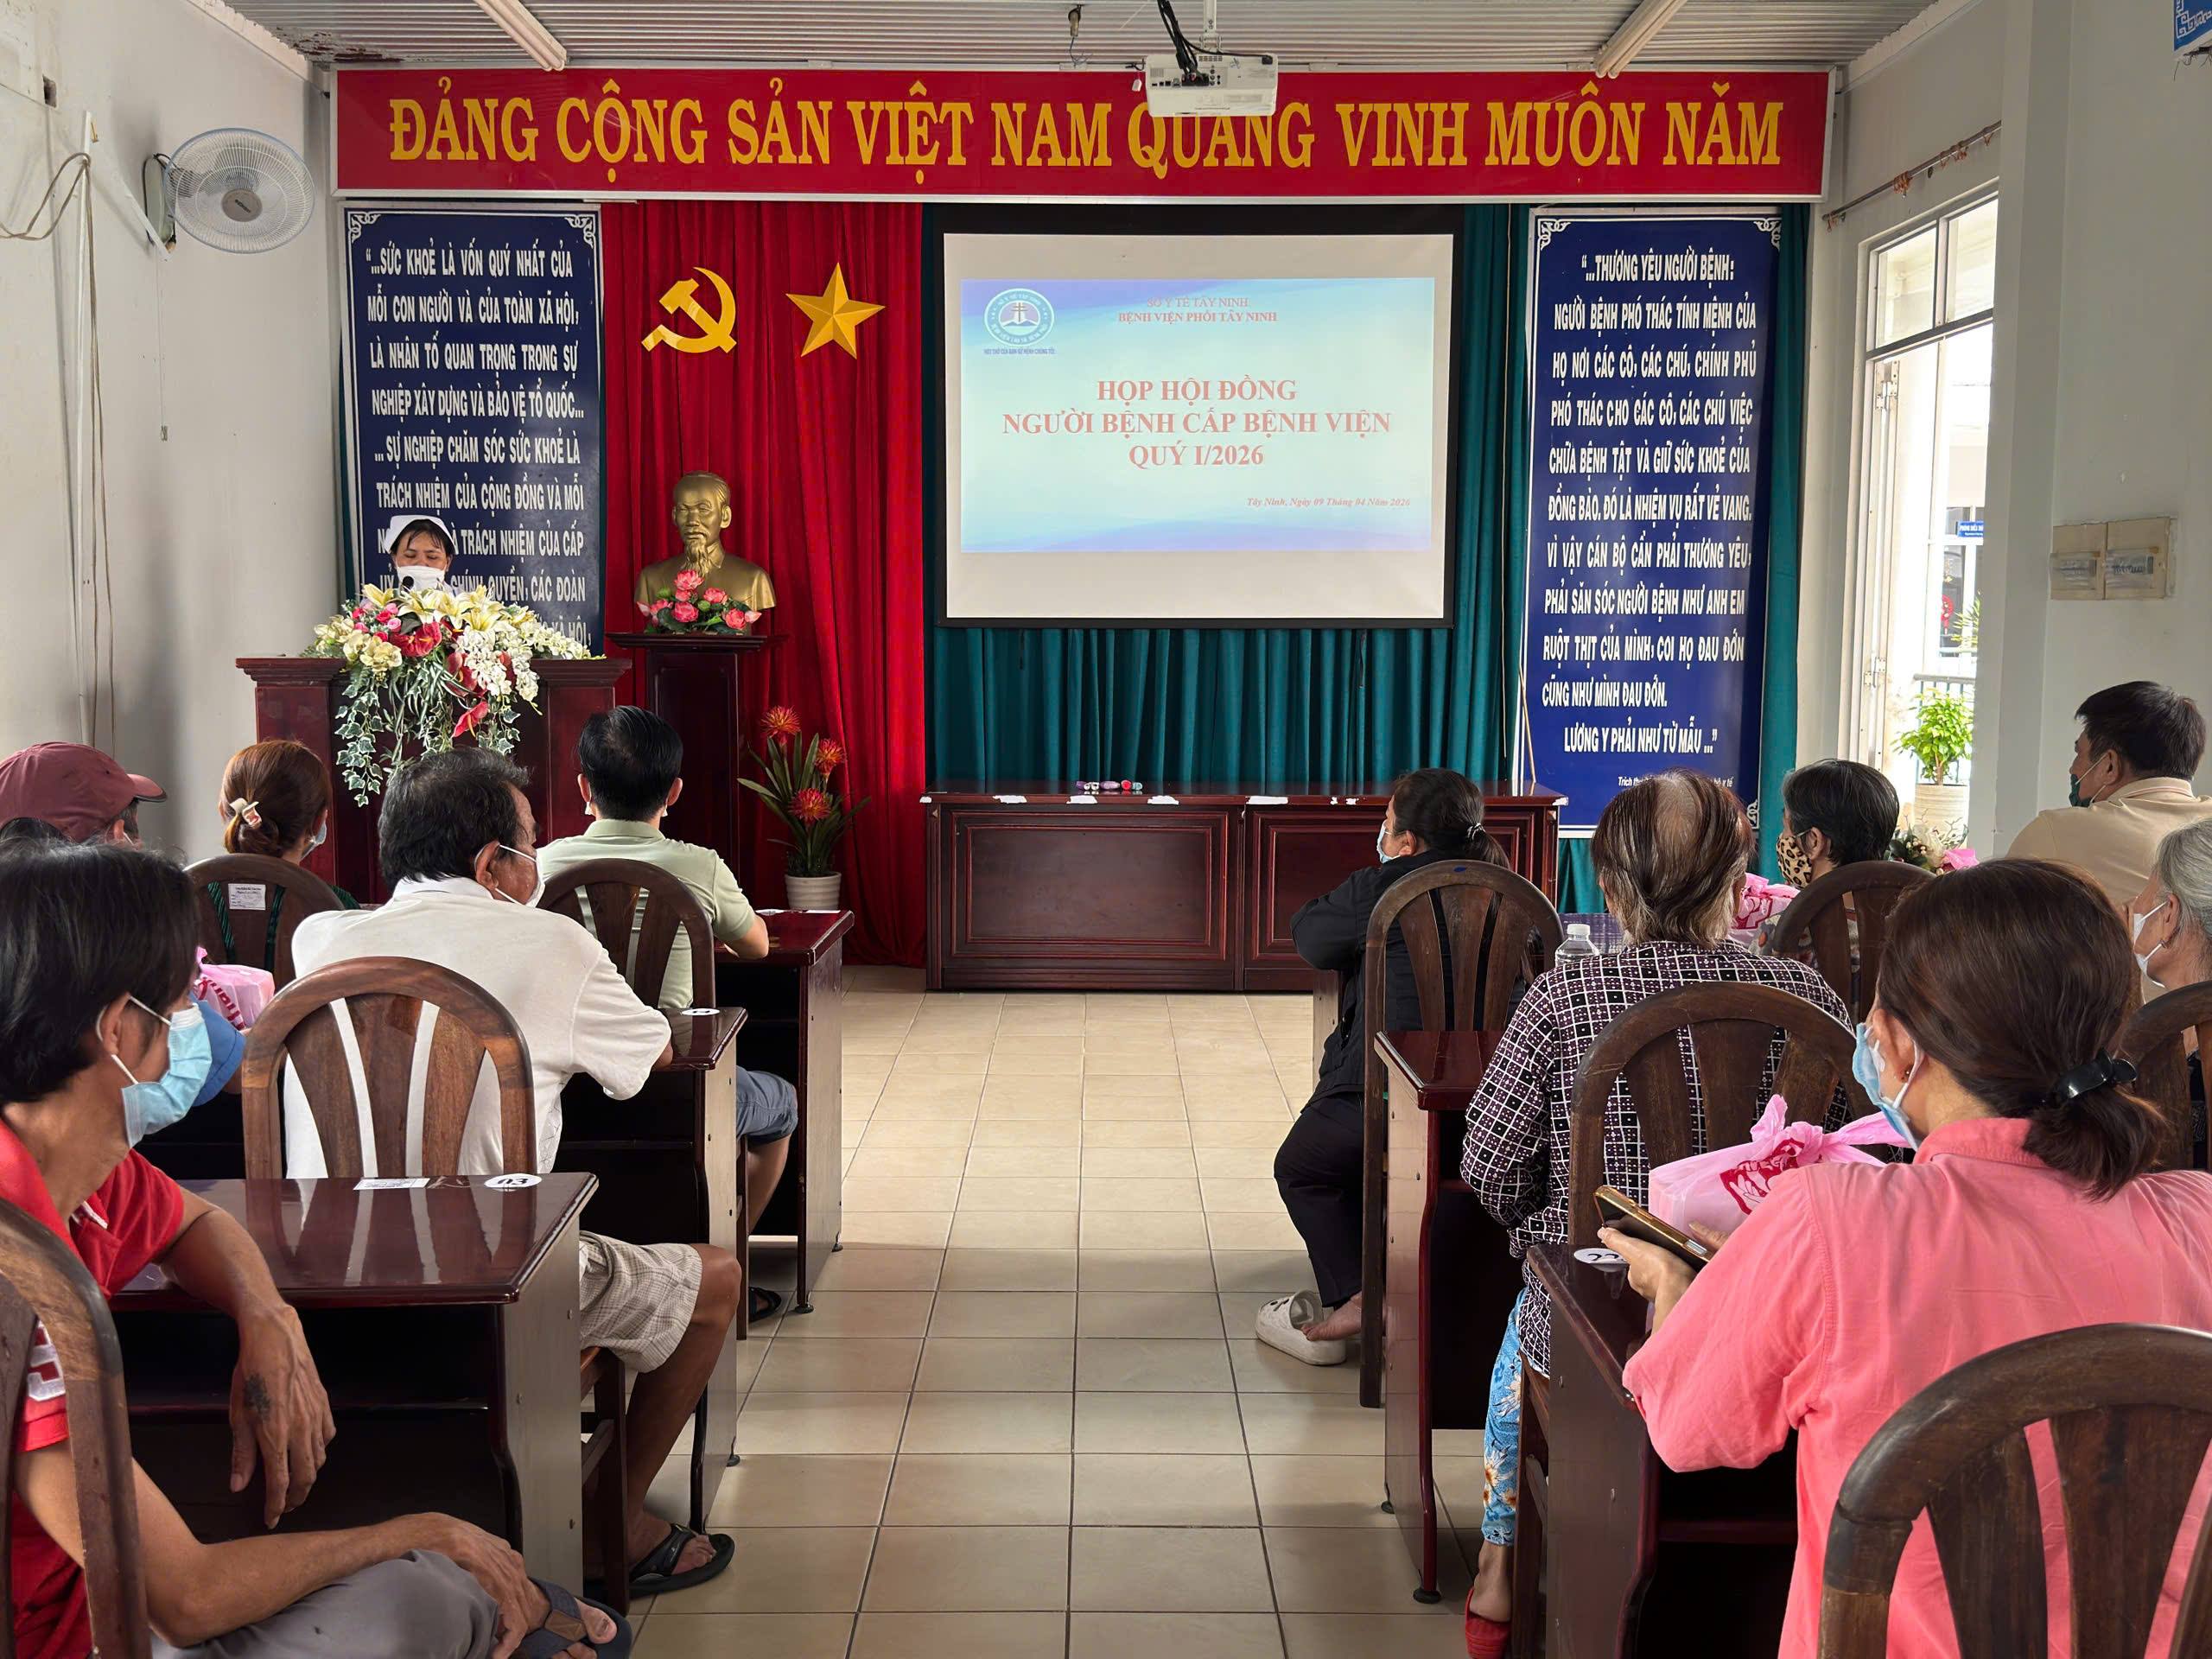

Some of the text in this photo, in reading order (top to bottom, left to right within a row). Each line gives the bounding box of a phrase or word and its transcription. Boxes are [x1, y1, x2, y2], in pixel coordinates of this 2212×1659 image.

[391, 77, 1783, 184] ĐẢNG CỘNG SẢN VIỆT NAM QUANG VINH MUÔN NĂM
[407, 238, 573, 277] KHOẺ LÀ VỐN QUÝ NHẤT CỦA
[1641, 245, 1697, 281] YÊU NGƯỜI
[393, 287, 553, 324] CON NGƯỜI VÀ CỦA TOÀN XÃ
[1119, 311, 1151, 324] BỆNH
[1154, 311, 1184, 324] VIỆN
[1219, 309, 1243, 321] TÂY
[1246, 312, 1278, 321] NINH
[1217, 298, 1249, 308] NINH
[1554, 292, 1756, 337] NGƯỜI BỆNH PHÓ THÁC TÍNH MỆNH CỦA
[371, 331, 578, 378] LÀ NHÂN TỐ QUAN TRỌNG TRONG SỰ
[1553, 340, 1756, 386] HỌ NƠI CÁC CÁC CHÍNH PHỦ
[372, 378, 543, 423] NGHIỆP XÂY DỰNG VÀ BẢO VỆ TỔ
[1097, 374, 1297, 406] HỌP HỘI ĐỒNG
[1002, 407, 1392, 439] NGƯỜI BỆNH CẤP BỆNH VIỆN
[1551, 391, 1752, 432] PHÓ THÁC CHO CÁC CÁC CHÚ VIỆC
[386, 428, 580, 469] SỰ NGHIỆP CHĂM SÓC SỨC KHOẺ LÀ
[1128, 440, 1264, 469] QUÝ I/2026
[1549, 435, 1750, 481] CHỮA BỆNH TẬT VÀ GIỮ SỨC KHOẺ CỦA
[377, 473, 562, 517] TRÁCH NHIỆM CỦA CỘNG ĐỒNG VÀ
[1604, 483, 1720, 528] ĐÓ LÀ NHIỆM VỤ RẤT VẺ
[461, 519, 583, 563] TRÁCH NHIỆM CỦA CẤP
[1548, 532, 1724, 575] VÌ VẬY CÁN BỘ PHẢI THƯƠNG
[531, 569, 585, 601] CÁC ĐOÀN
[1545, 578, 1745, 622] PHẢI SĂN SÓC NGƯỜI BỆNH NHƯ ANH EM
[1543, 624, 1744, 670] RUỘT THỊT CỦA COI HỌ ĐAU ĐỚN
[1542, 674, 1642, 707] CŨNG NHƯ MÌNH ĐAU
[1565, 716, 1701, 753] LƯƠNG Y PHẢI NHƯ TỪ MẪU
